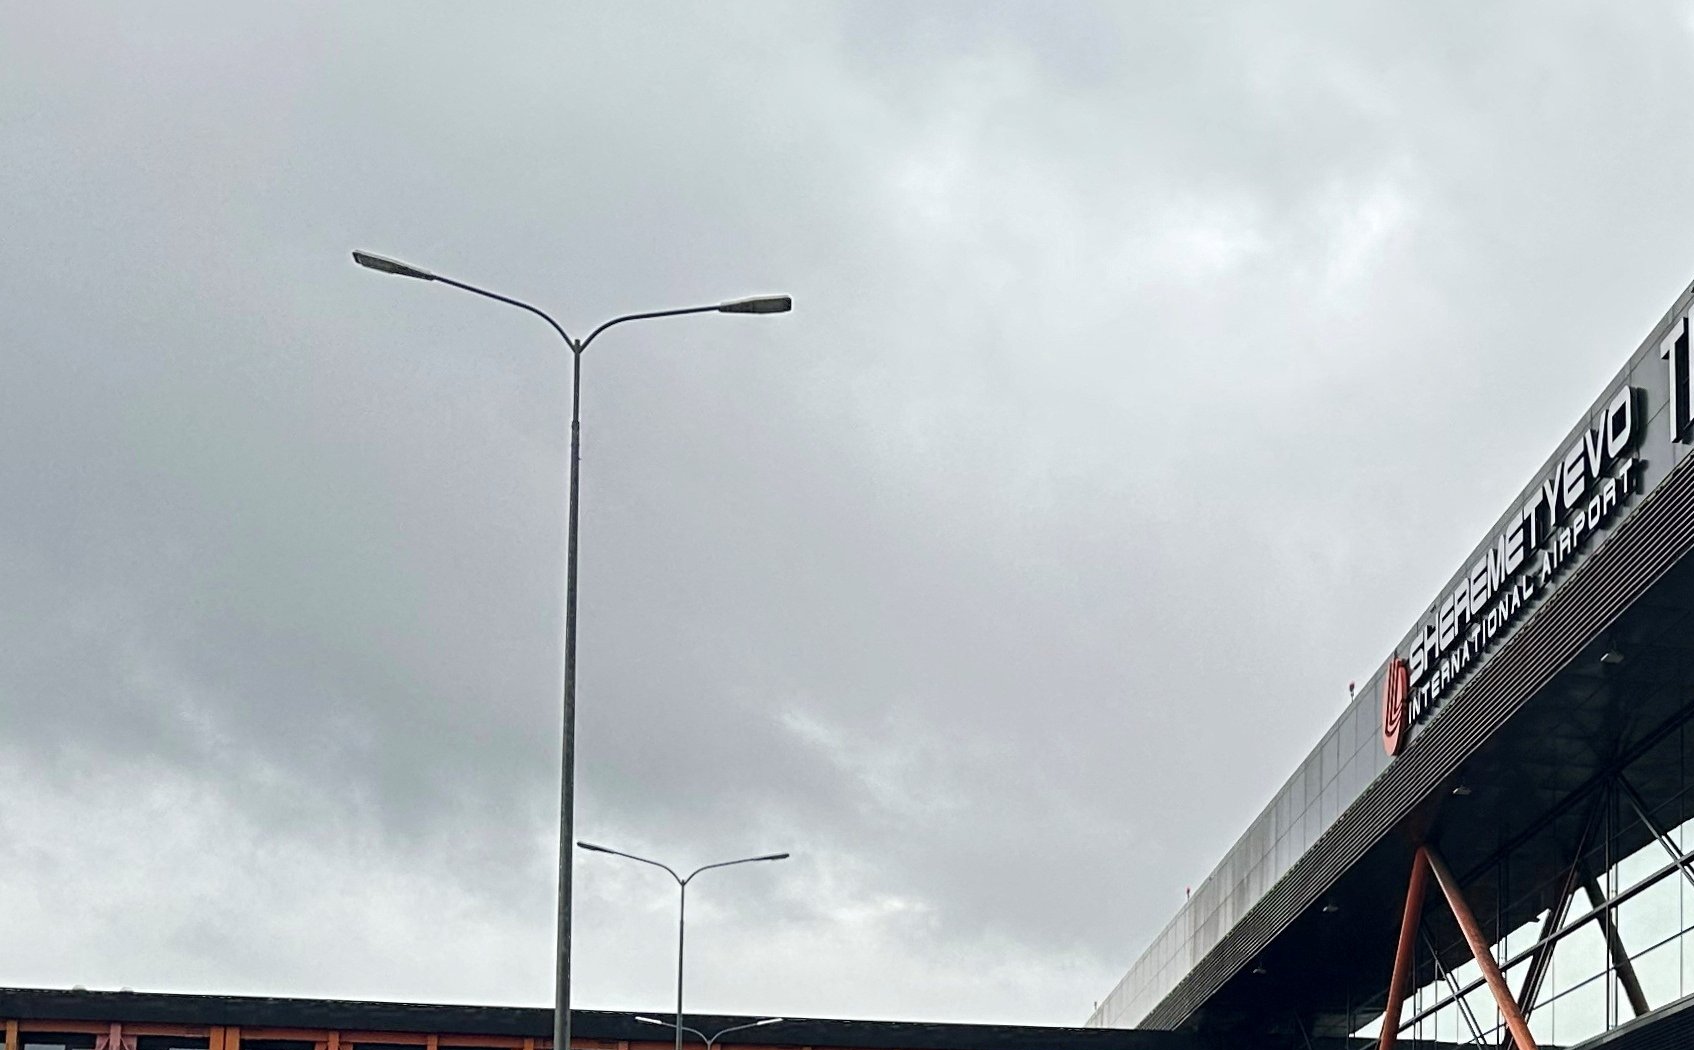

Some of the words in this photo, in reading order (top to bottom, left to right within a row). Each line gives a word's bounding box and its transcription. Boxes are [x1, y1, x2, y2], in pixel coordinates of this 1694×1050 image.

[1408, 575, 1534, 724] INTERNATIONAL
[1541, 457, 1633, 583] AIRPORT
[1409, 385, 1632, 687] SHEREMETYEVO
